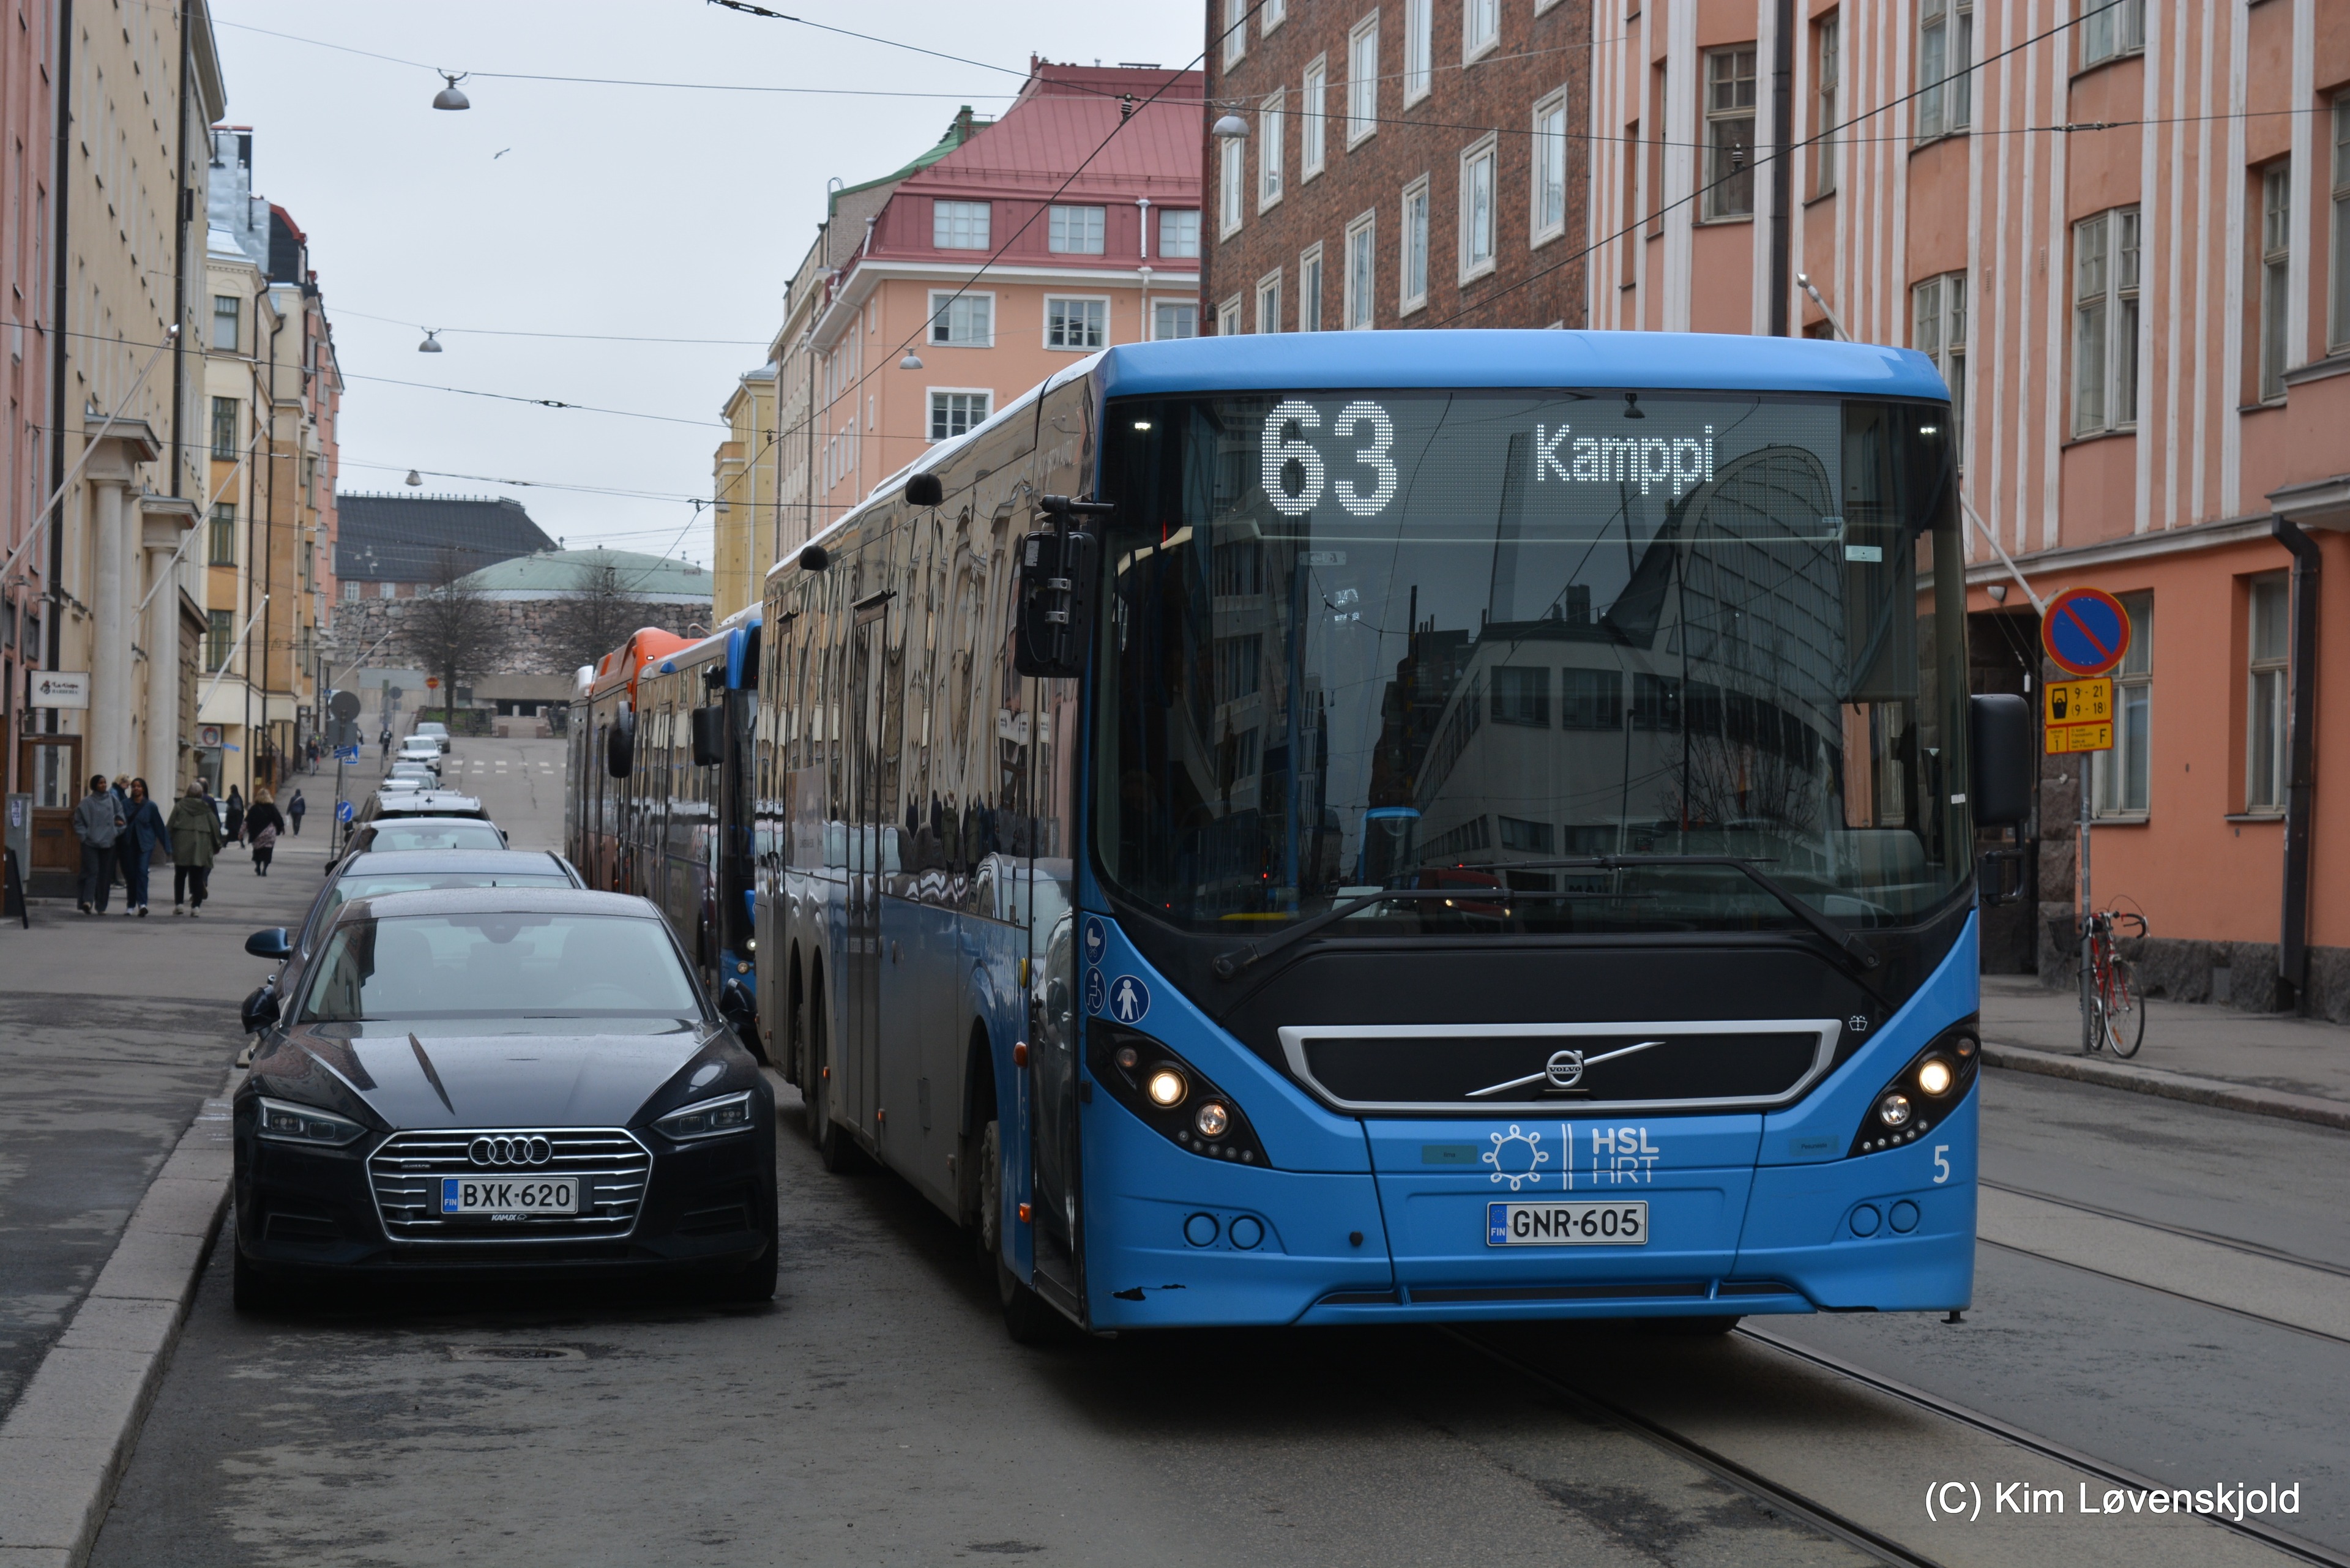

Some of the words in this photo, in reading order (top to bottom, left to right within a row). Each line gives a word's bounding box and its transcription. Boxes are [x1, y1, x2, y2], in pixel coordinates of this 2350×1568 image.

[1262, 400, 1397, 516] 63
[1537, 424, 1713, 495] Kamppi
[2074, 687, 2081, 700] 9
[2093, 685, 2103, 698] 21
[2072, 704, 2081, 716] (9
[2093, 702, 2106, 715] 18)
[2055, 739, 2059, 751] 1
[2100, 728, 2107, 744] F
[1592, 1126, 1660, 1155] HSL
[1592, 1155, 1660, 1184] HRT
[1933, 1144, 1950, 1184] 5
[463, 1183, 570, 1207] BXK-620
[1491, 1228, 1505, 1236] FIN
[1512, 1208, 1641, 1238] GNR-605
